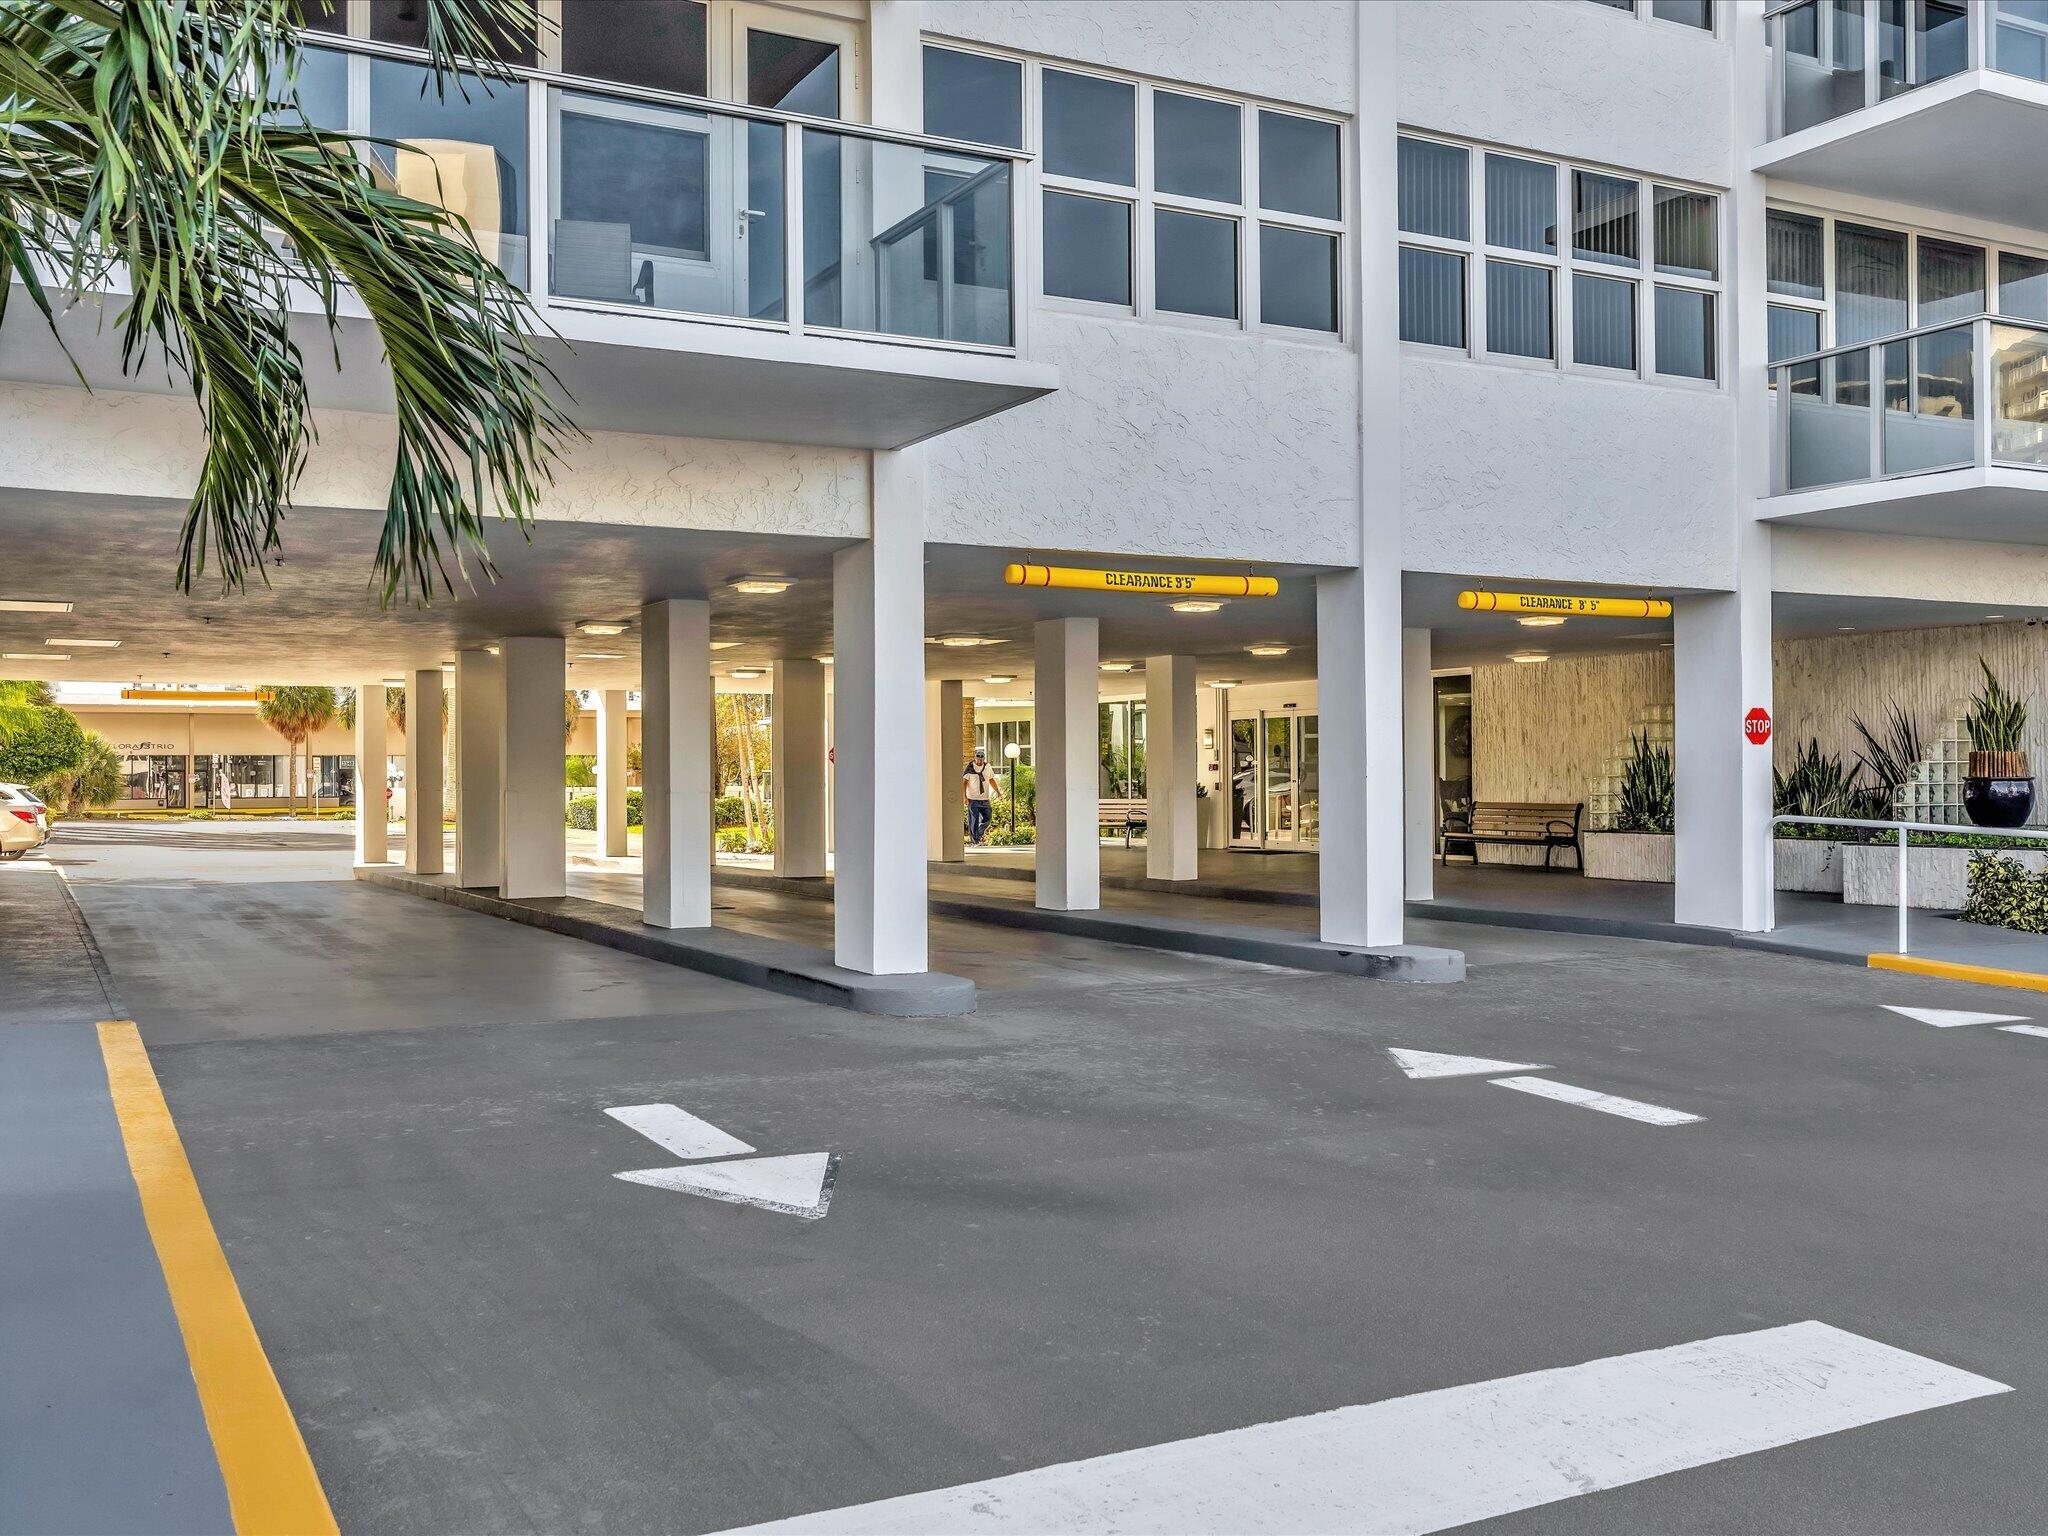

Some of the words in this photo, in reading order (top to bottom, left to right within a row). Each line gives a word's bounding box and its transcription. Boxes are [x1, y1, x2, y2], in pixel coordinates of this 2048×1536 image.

[1105, 573, 1173, 589] CLEARANCE
[1520, 596, 1573, 610] CLEARANCE
[1745, 719, 1771, 734] STOP
